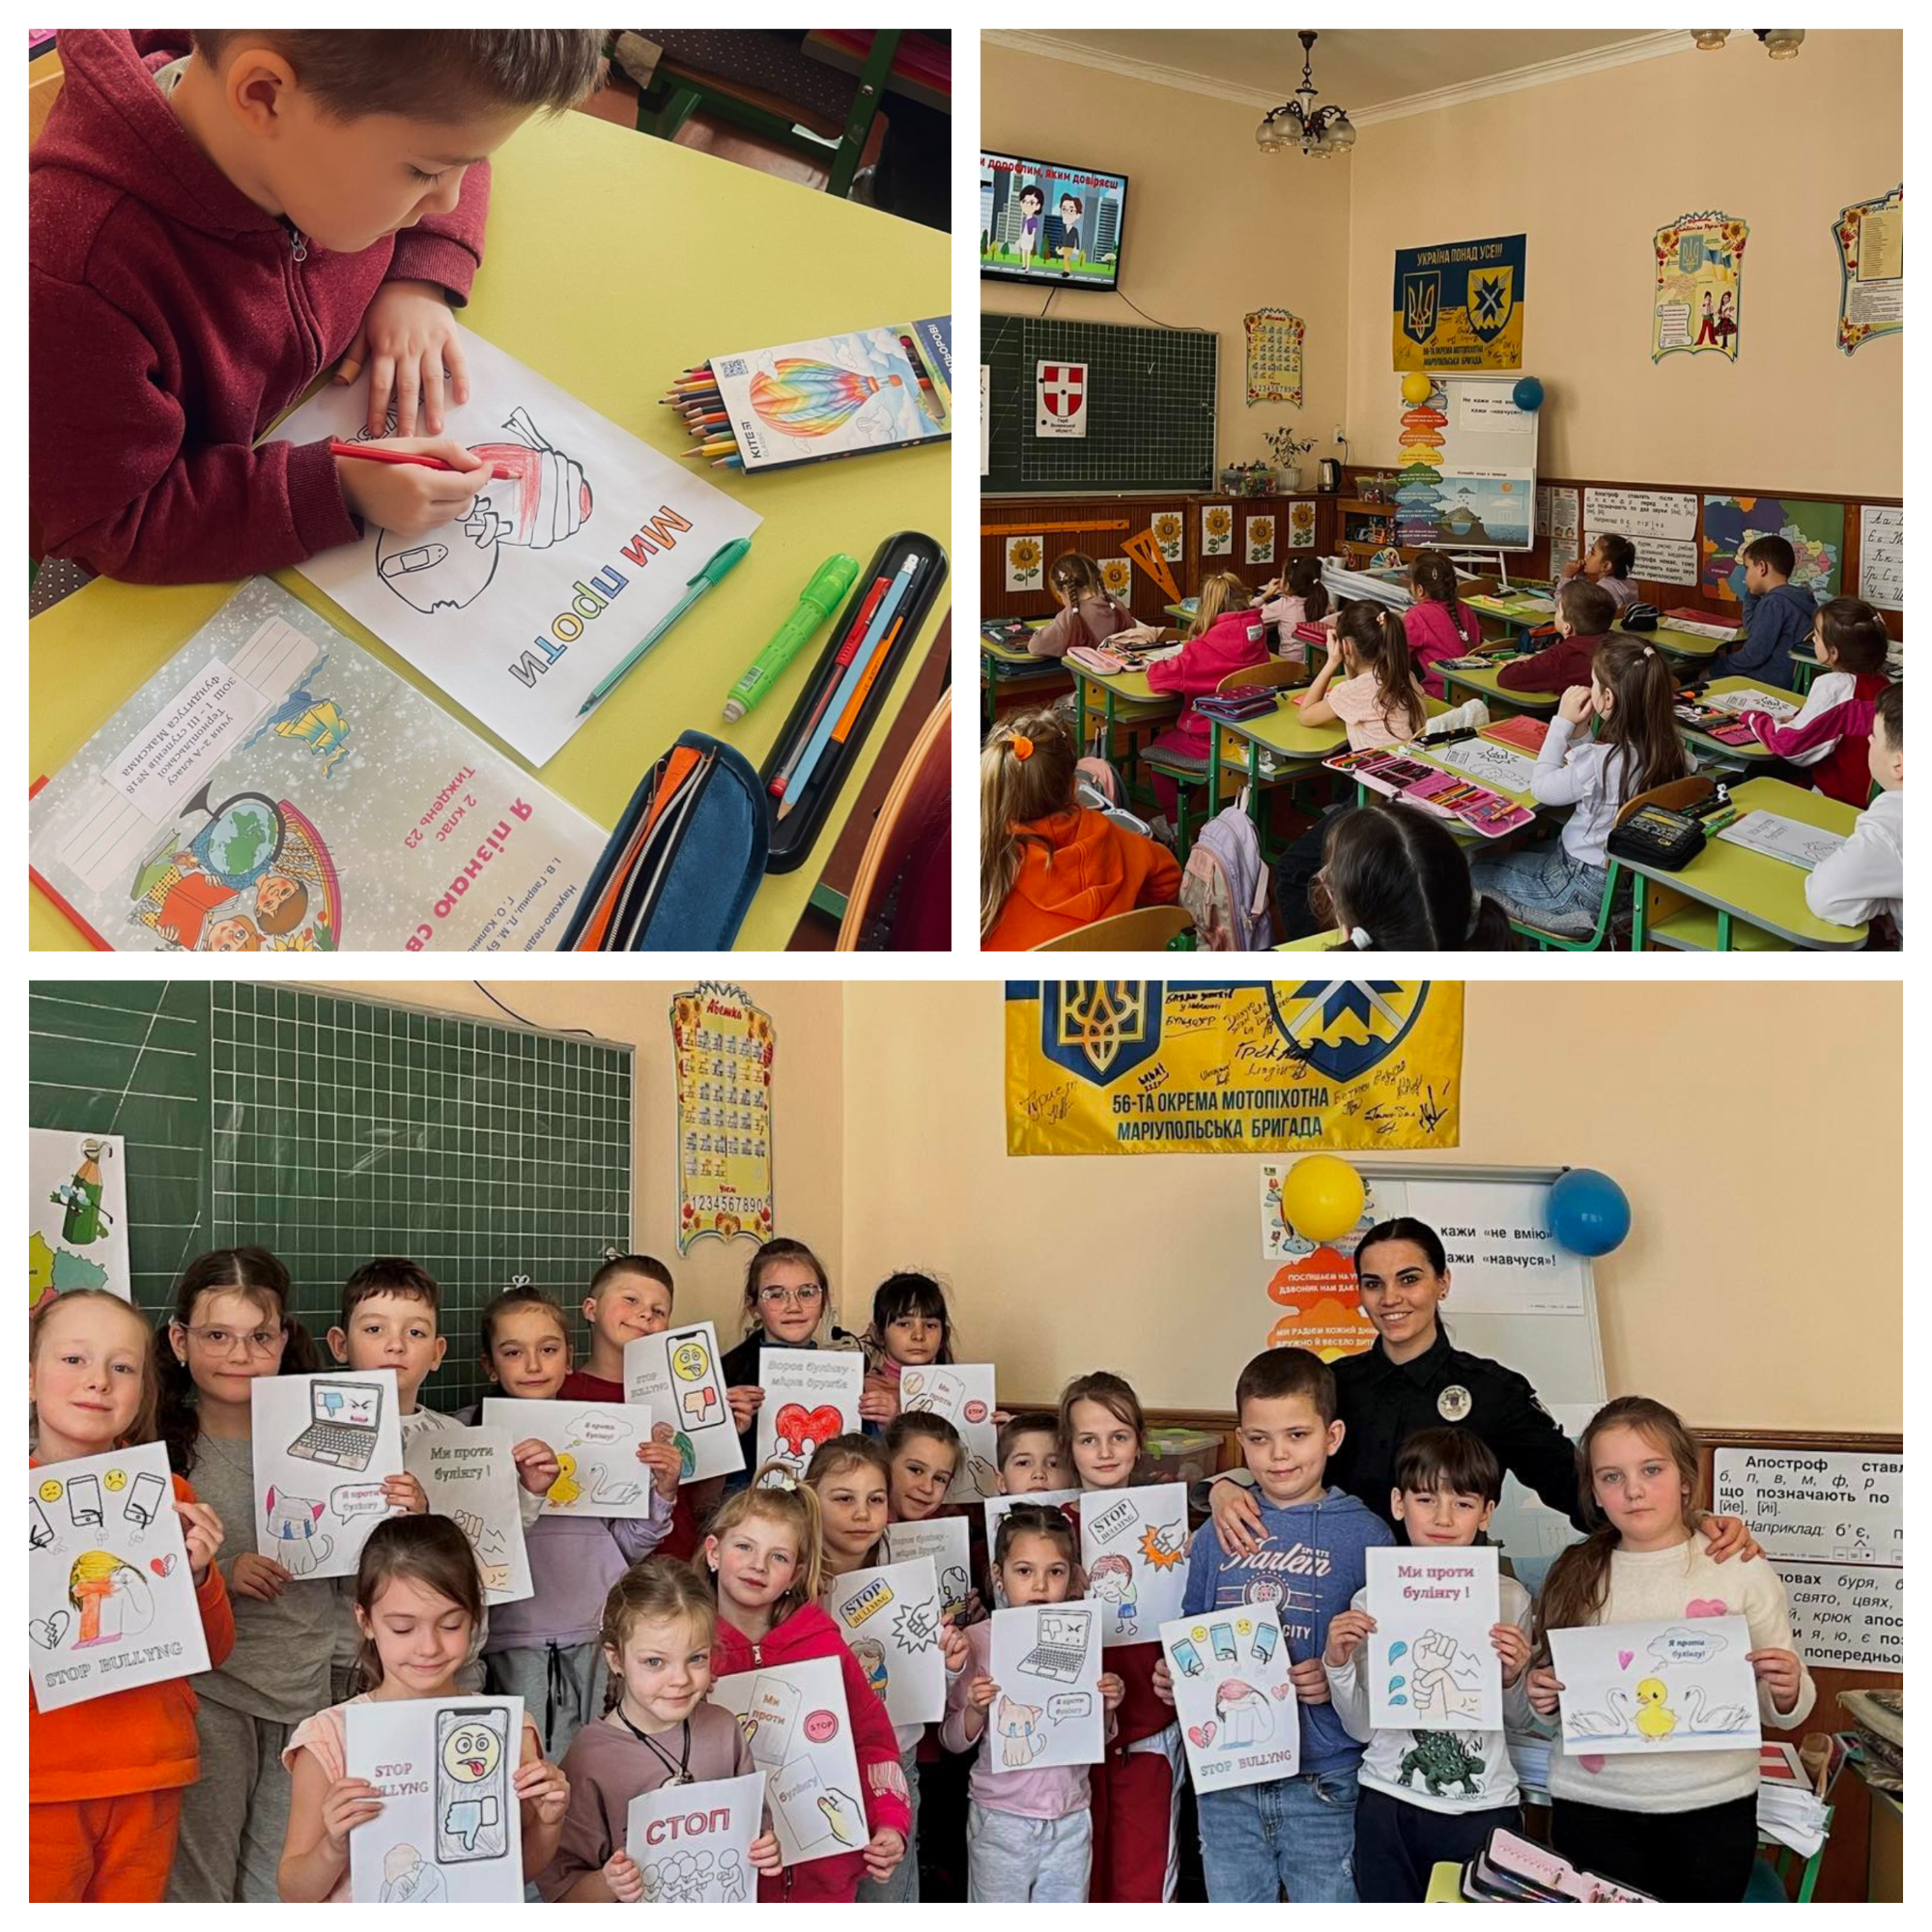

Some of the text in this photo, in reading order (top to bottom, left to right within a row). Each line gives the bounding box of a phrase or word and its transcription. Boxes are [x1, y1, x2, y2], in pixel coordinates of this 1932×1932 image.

[1045, 167, 1071, 182] яким
[1072, 174, 1119, 190] довіряєш
[1417, 249, 1450, 267] УКРАЇНА
[1451, 246, 1478, 262] ПОНАД
[745, 431, 762, 459] KITE
[507, 505, 694, 689] Ми проти
[213, 676, 237, 701] ЗОШ
[122, 675, 220, 777] Фундитуса Максима
[212, 714, 234, 739] учня
[149, 728, 187, 770] ступенів
[157, 708, 225, 780] Тернопільської
[167, 759, 194, 786] класу
[404, 766, 476, 849] Тиждень 23
[436, 794, 477, 841] 2 клас
[434, 797, 533, 919] Я пізнаю
[706, 999, 742, 1020] Абетка
[1113, 1087, 1329, 1113] 56-ТА ОКРЕМА МОТОПІХОТНА
[1118, 1117, 1322, 1141] МАРІУПОЛЬСЬКА БРИГАДА
[1440, 1227, 1476, 1237] кажи
[1484, 1228, 1507, 1238] «не
[1446, 1254, 1556, 1268] ажи «навчуся»!
[1279, 1285, 1319, 1294] ДЗВОНИК
[636, 1372, 657, 1384] STOP
[430, 1446, 494, 1461] Ми проти
[1746, 1456, 1828, 1473] Апостроф
[435, 1467, 483, 1483] булінгу
[1719, 1469, 1875, 1490] б, п, в, м, ф, р
[351, 1490, 380, 1500] проти
[1719, 1487, 1890, 1504] що позначають по
[1094, 1500, 1129, 1533] STOP
[1744, 1520, 1826, 1536] Наприклад:
[1398, 1565, 1475, 1581] Ми проти
[1837, 1575, 1879, 1590] буря,
[845, 1581, 882, 1615] STOP
[1403, 1585, 1461, 1602] булінгу
[1793, 1592, 1893, 1609] свято, цвях,
[1812, 1611, 1852, 1624] крюк
[1283, 1624, 1311, 1640] CITY
[1811, 1629, 1825, 1641] я,
[45, 1641, 184, 1688] STOP BULLYNG
[1804, 1647, 1903, 1664] попередньо
[762, 1693, 780, 1707] Ми
[752, 1710, 785, 1726] проти
[810, 1721, 833, 1732] STOP
[375, 1763, 412, 1777] STOP
[1201, 1749, 1292, 1776] STOP BULLYNG
[646, 1808, 730, 1846] СТОП
